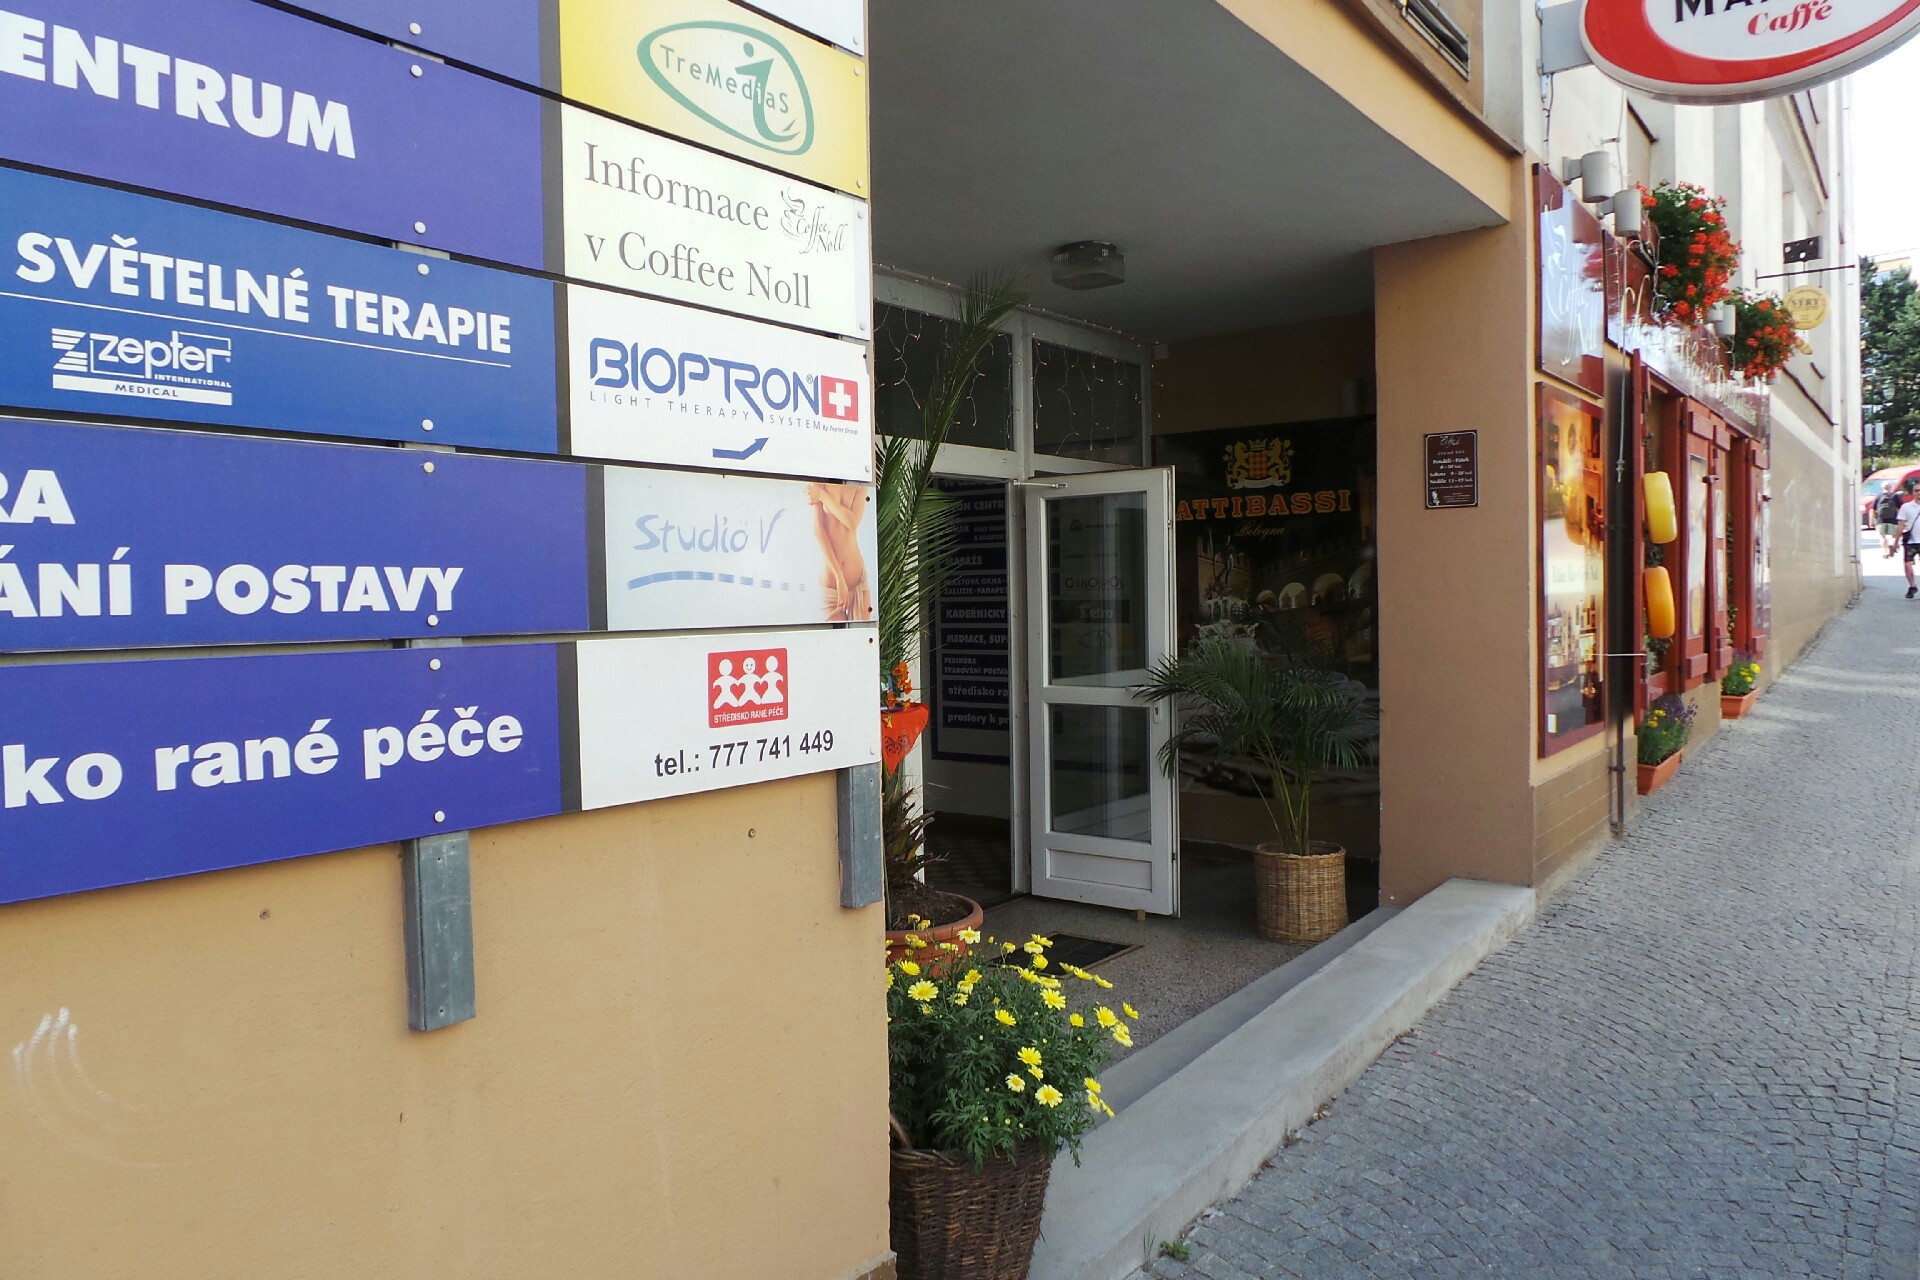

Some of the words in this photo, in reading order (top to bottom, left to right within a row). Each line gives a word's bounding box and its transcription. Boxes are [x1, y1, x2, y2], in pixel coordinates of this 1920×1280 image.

[0, 9, 356, 159] ENTRUM
[584, 141, 769, 231] Informace
[816, 223, 849, 253] Noll
[15, 232, 310, 324] SVĚTELNÉ
[327, 285, 511, 354] TERAPIE
[584, 233, 606, 263] v
[618, 231, 735, 292] Coffee
[745, 260, 812, 309] Noll
[89, 330, 232, 379] zepter
[114, 383, 179, 398] MEDICAL
[154, 373, 232, 388] INTERNATIONAL
[590, 390, 651, 409] LIGHT
[667, 400, 749, 421] THERAPY
[769, 414, 821, 430] SYSTEM
[1175, 489, 1352, 521] ATTIBASSI
[632, 511, 749, 554] Studio
[759, 508, 788, 554] V
[1233, 520, 1286, 542] Bologna
[163, 563, 464, 616] POSTAVY
[713, 711, 750, 724] STŘEDISKO
[3, 743, 123, 809] ko
[154, 718, 339, 791] rané
[363, 705, 524, 780] péče
[654, 749, 701, 777] tel.:
[708, 741, 749, 769] 777
[756, 733, 791, 762] 741
[799, 729, 834, 754] 449
